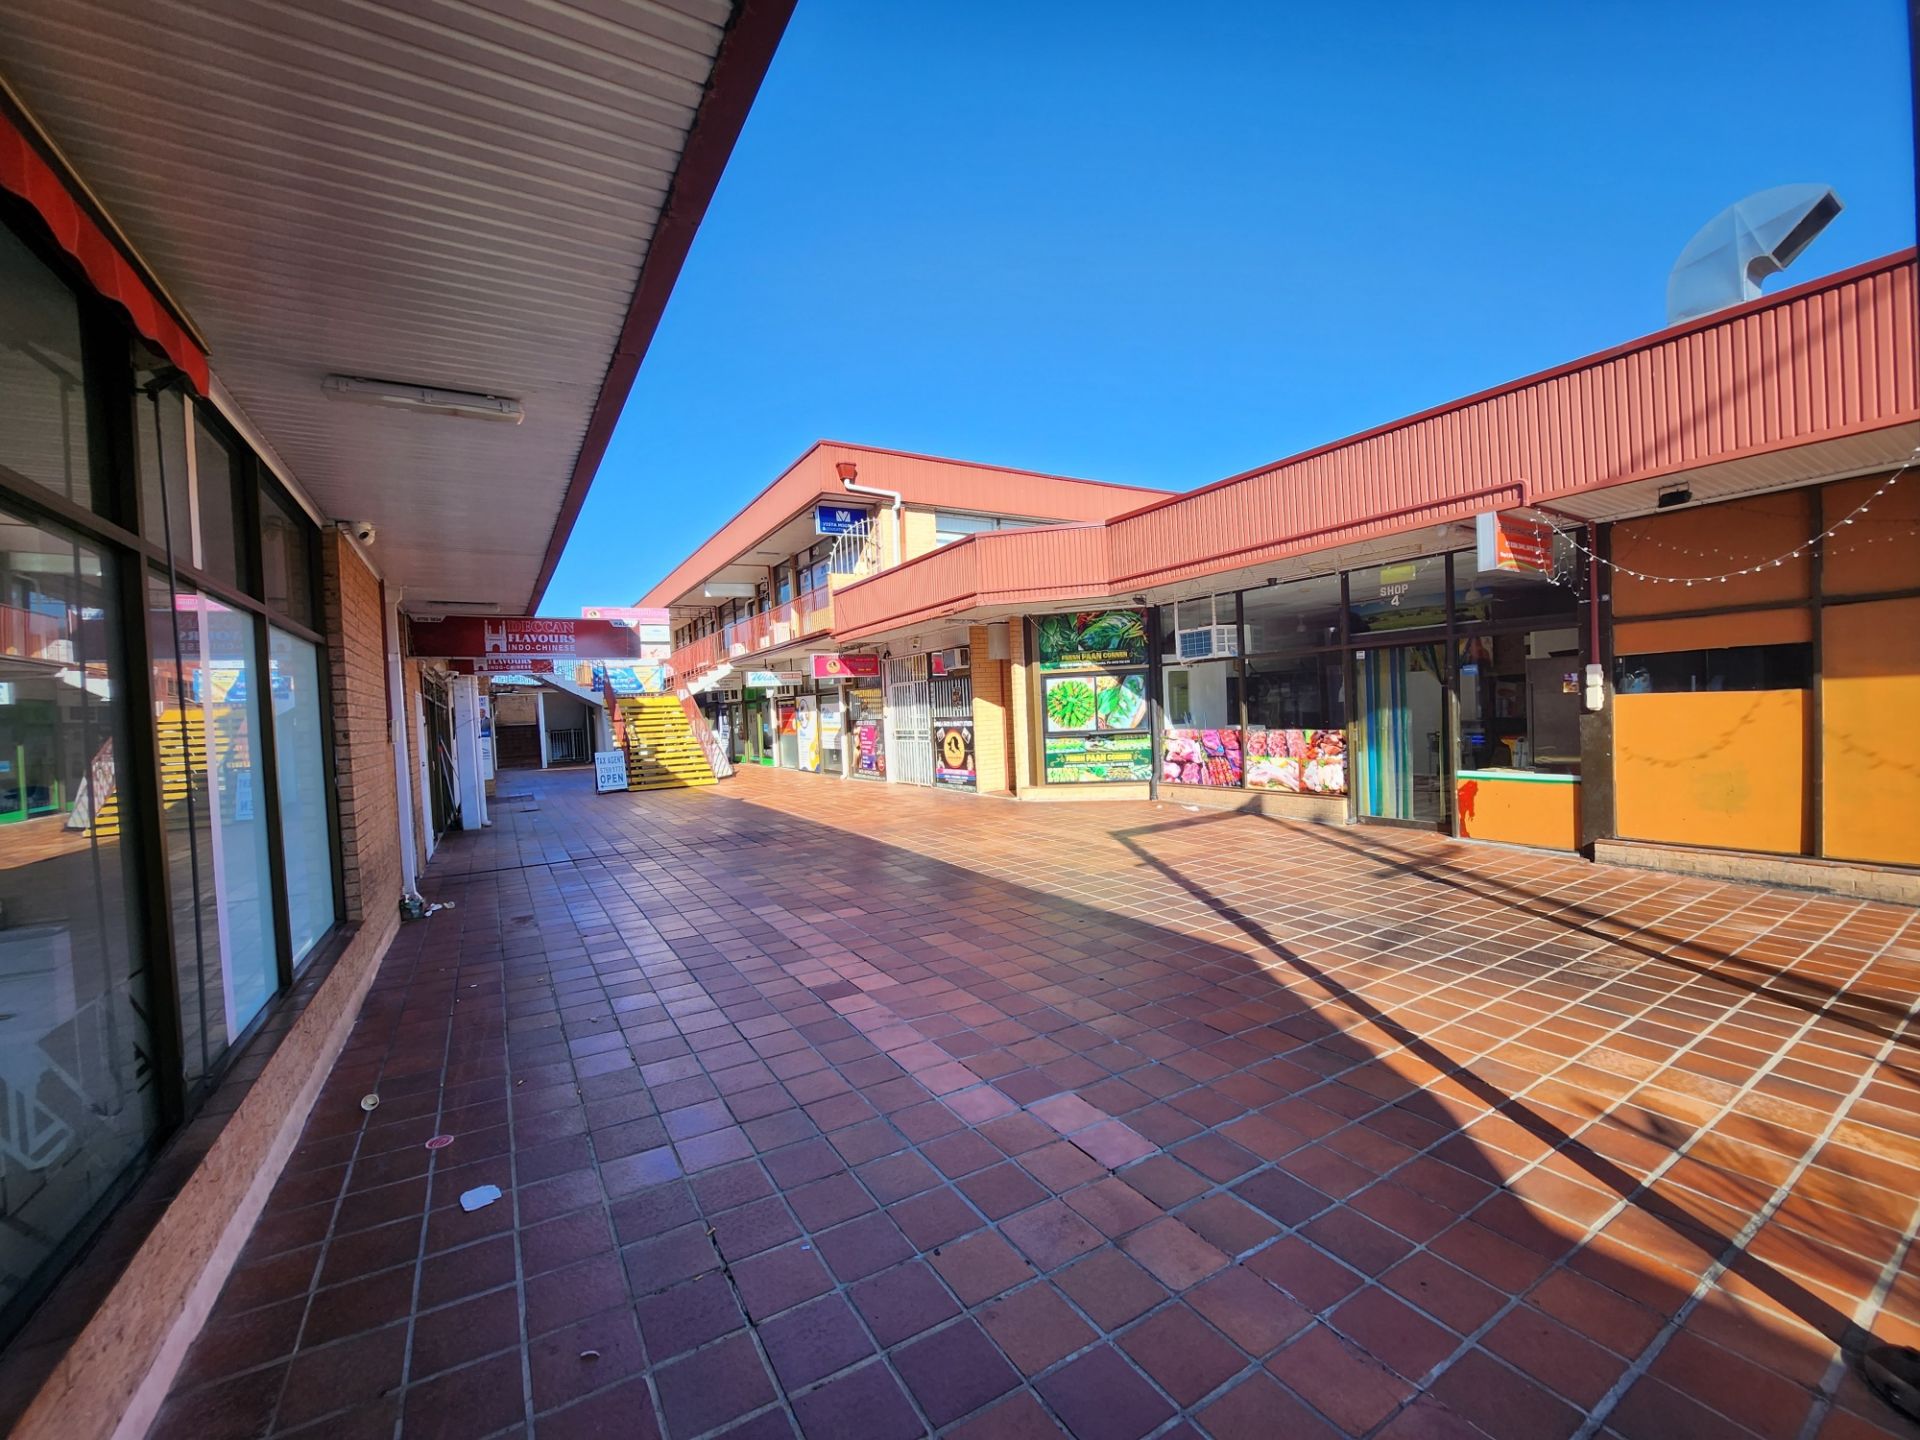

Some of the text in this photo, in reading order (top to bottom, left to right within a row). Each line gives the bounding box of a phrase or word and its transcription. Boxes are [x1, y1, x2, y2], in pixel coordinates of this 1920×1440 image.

[1380, 584, 1409, 597] SHOP
[1391, 595, 1401, 606] 4
[507, 620, 575, 633] DECCAN
[508, 634, 576, 643] FLAVOURS
[508, 644, 576, 652] INDO-CHINESE
[1082, 651, 1102, 660] PAAN
[1103, 651, 1128, 659] CORNER
[597, 755, 624, 765] TAX AGENT
[601, 773, 624, 784] OPEN
